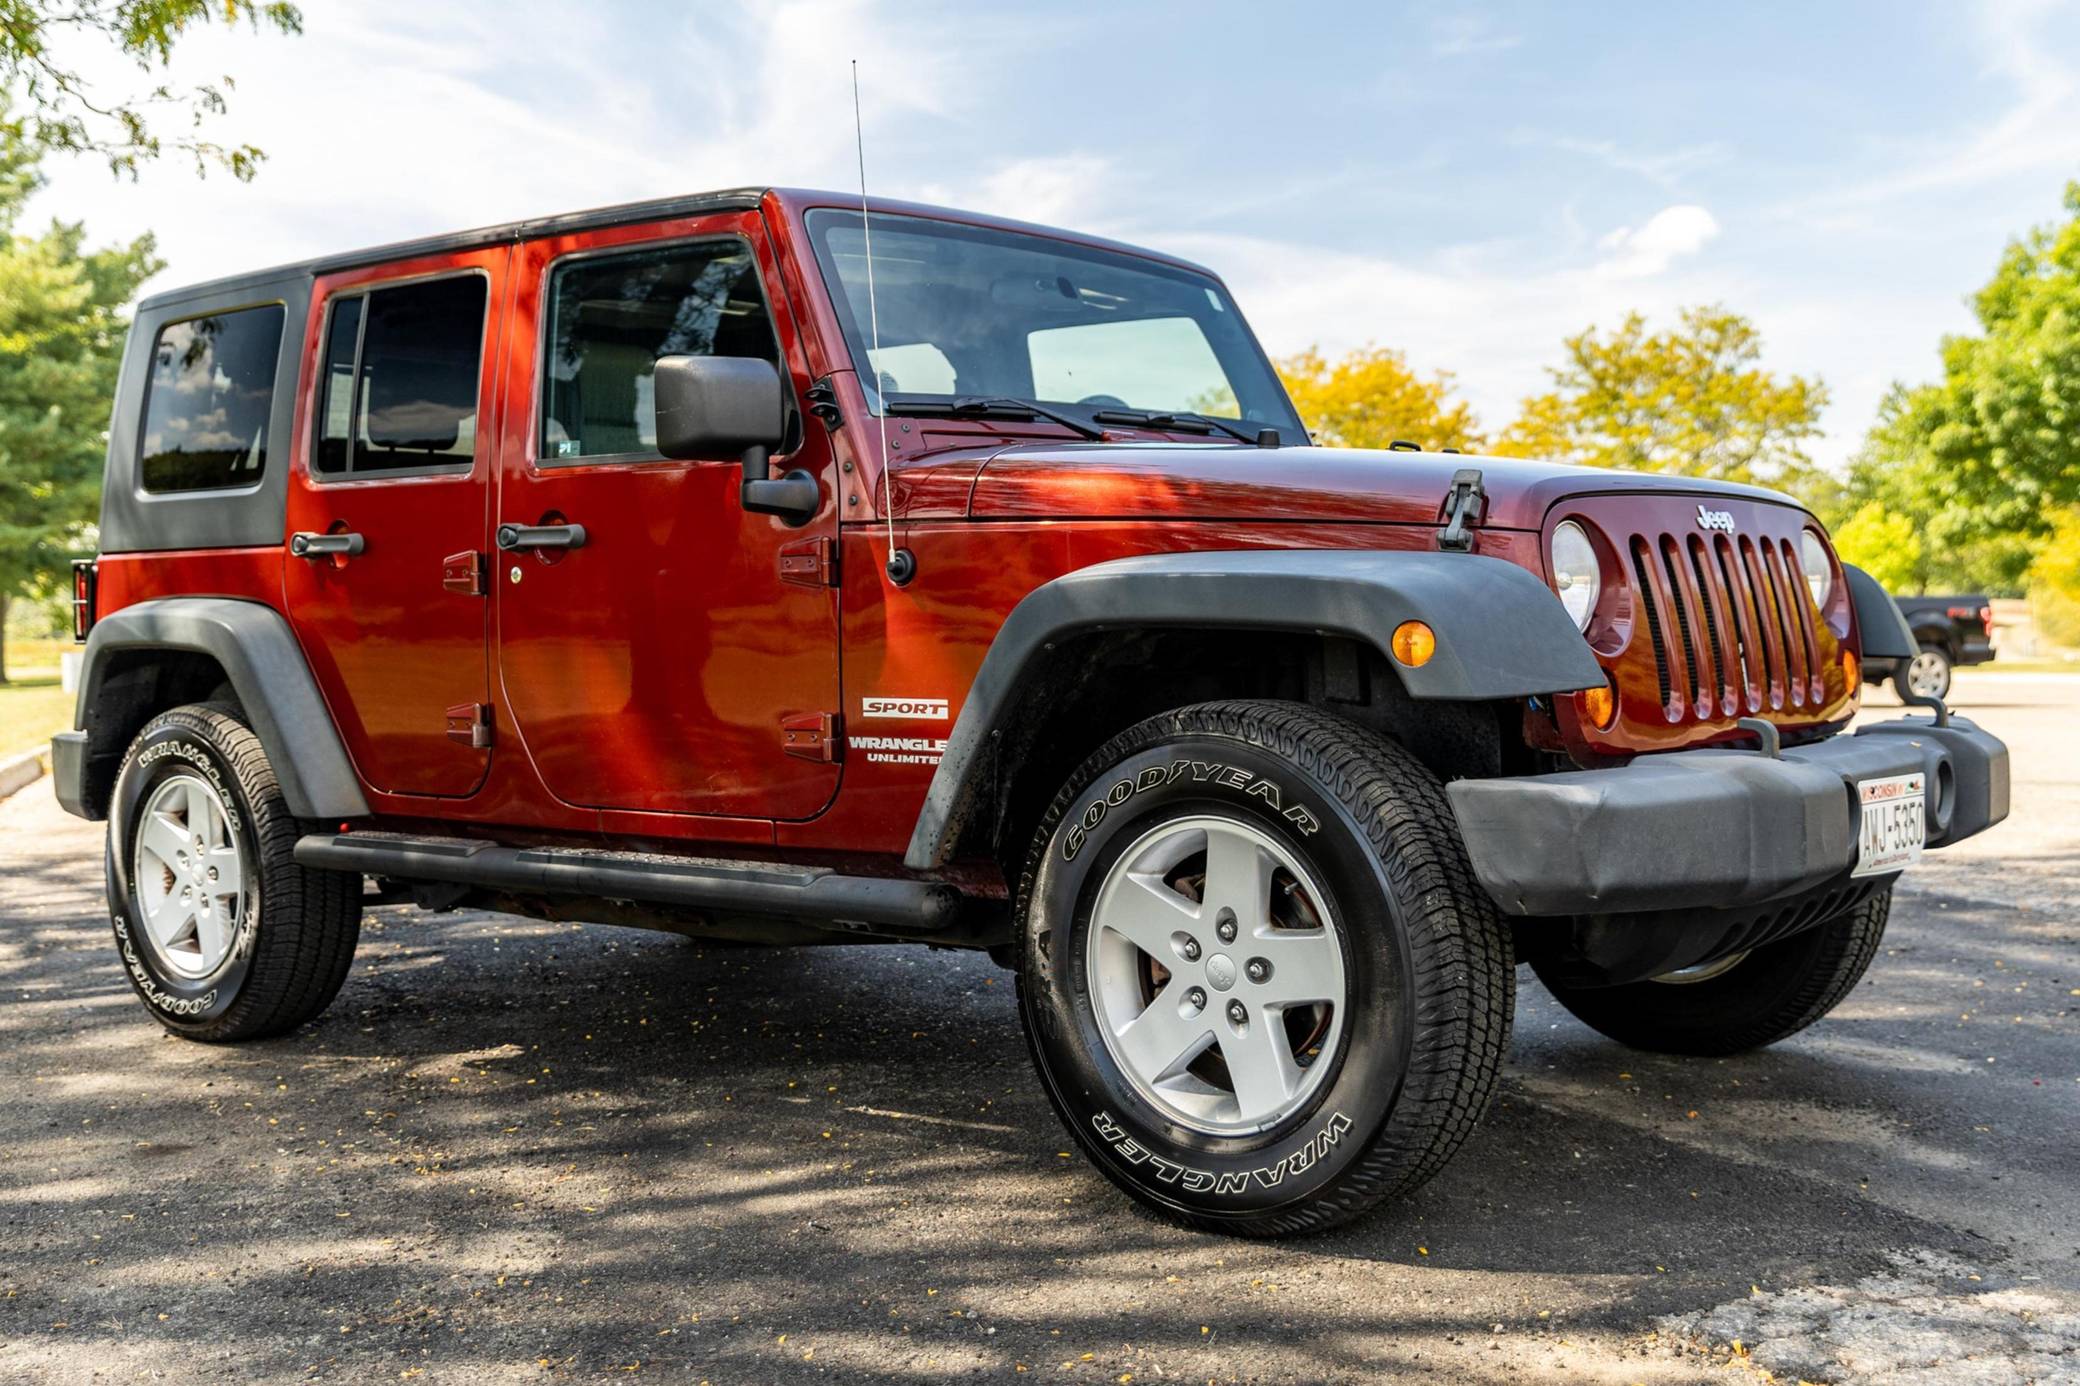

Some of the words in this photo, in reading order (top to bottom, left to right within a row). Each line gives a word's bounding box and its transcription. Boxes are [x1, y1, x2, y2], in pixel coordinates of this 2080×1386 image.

[1696, 505, 1735, 534] Jeep
[863, 701, 948, 715] SPORT
[867, 753, 943, 765] UNLIMITE
[1062, 759, 1321, 861] GOODYEAR
[1092, 1111, 1352, 1194] WRANGLER
